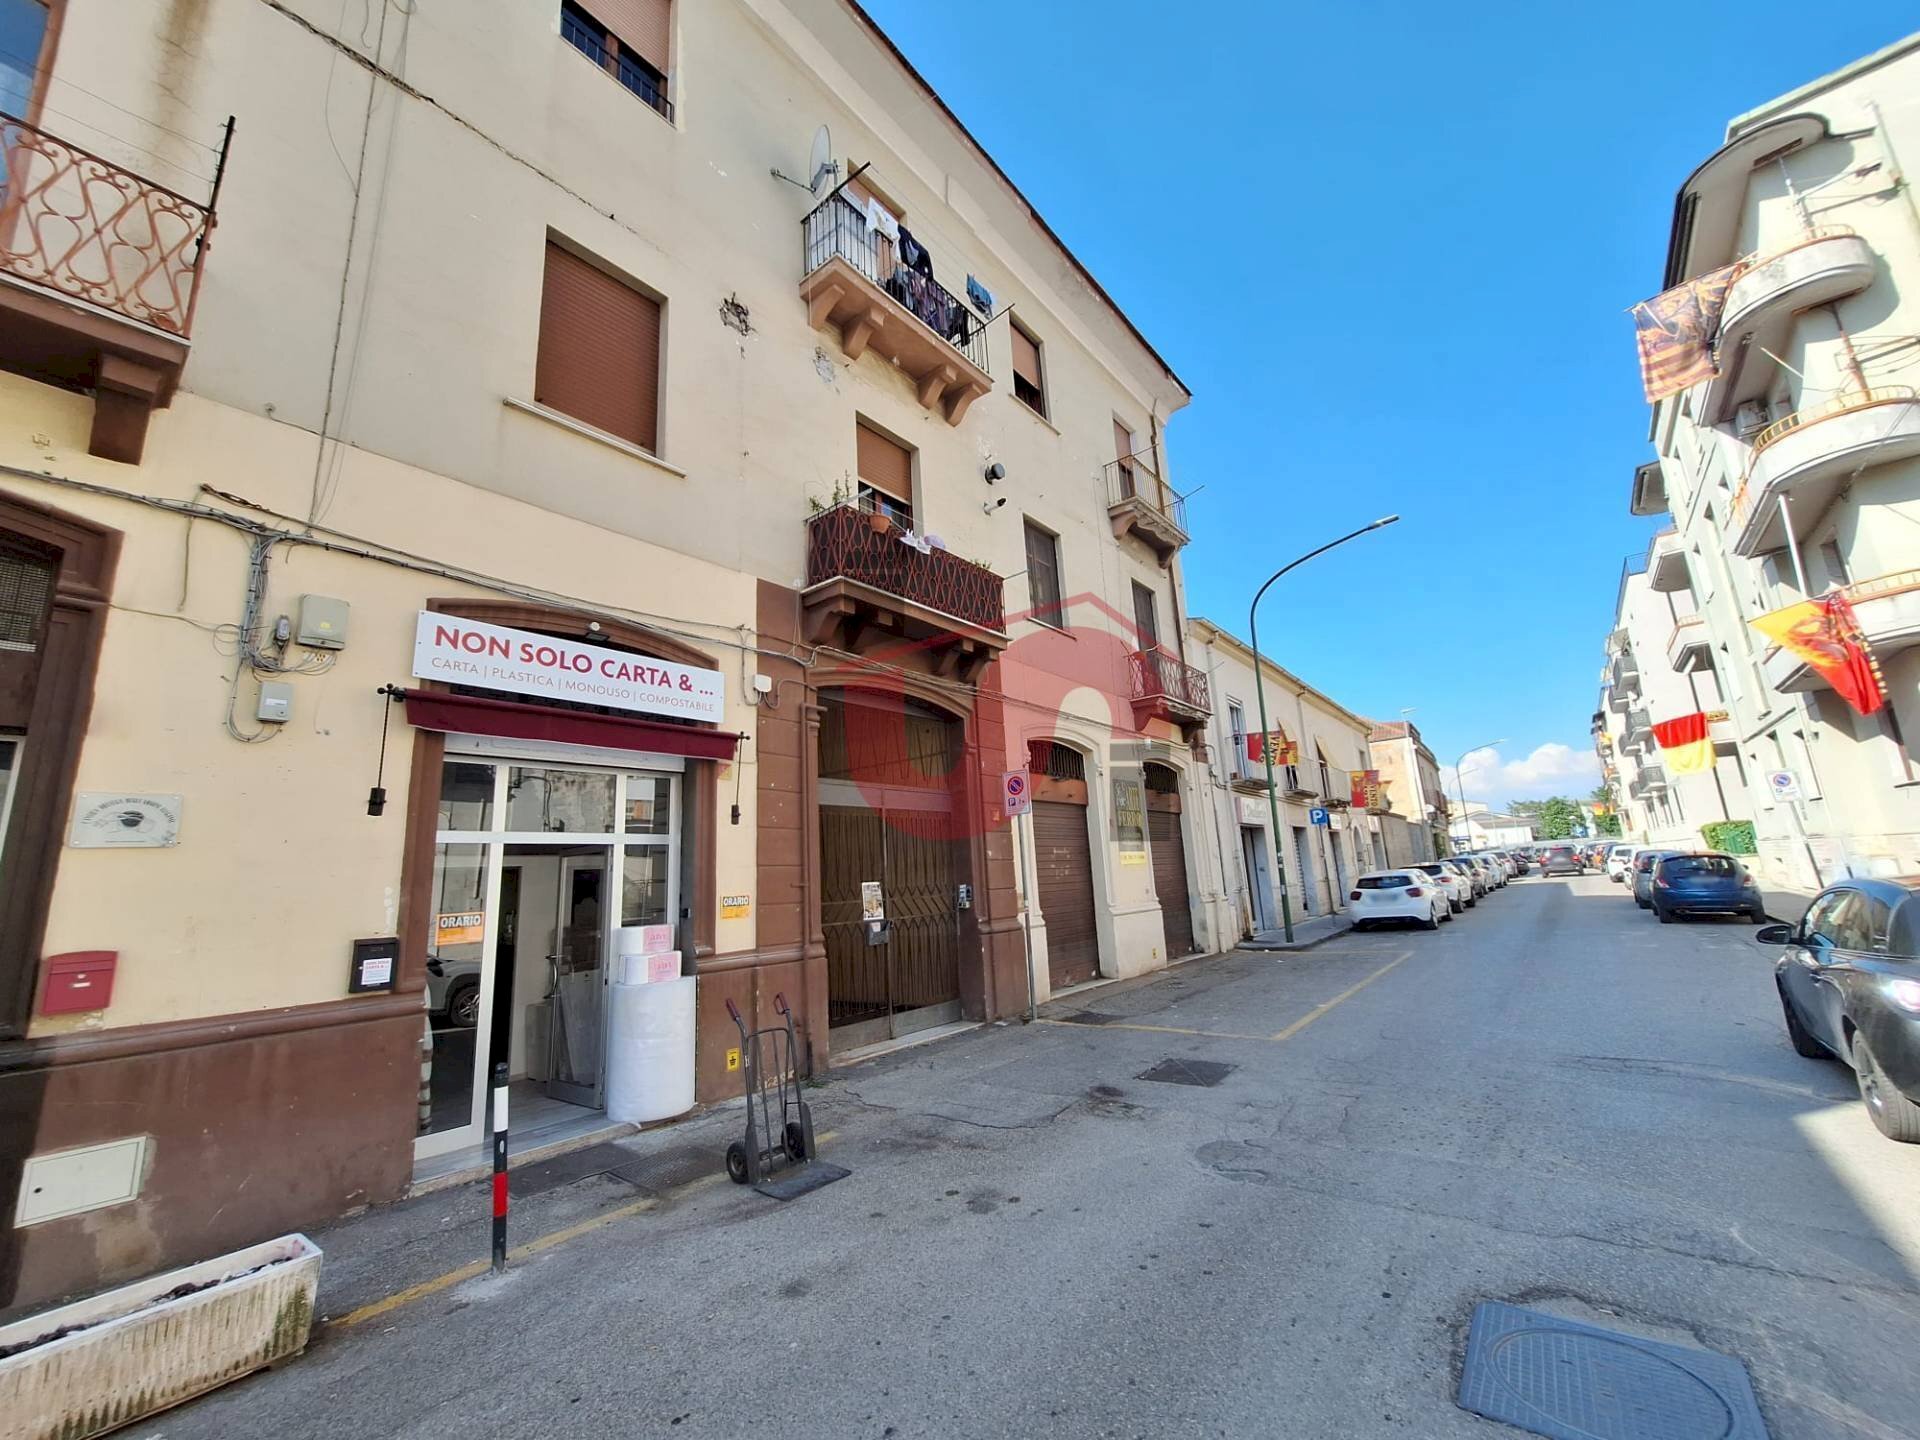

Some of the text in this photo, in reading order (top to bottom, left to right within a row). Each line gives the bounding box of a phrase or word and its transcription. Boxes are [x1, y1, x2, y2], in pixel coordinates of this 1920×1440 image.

[434, 625, 511, 660] NON
[519, 643, 593, 673] SOLO
[600, 659, 673, 688] CARTA
[678, 674, 694, 692] &
[431, 657, 479, 674] CARTA
[492, 667, 554, 688] PLASTICA
[565, 680, 631, 699] MONOUSO
[639, 692, 715, 713] COMPOSTABILE
[1311, 809, 1323, 823] P
[723, 896, 749, 907] ORARIO
[440, 914, 482, 928] ORARIO
